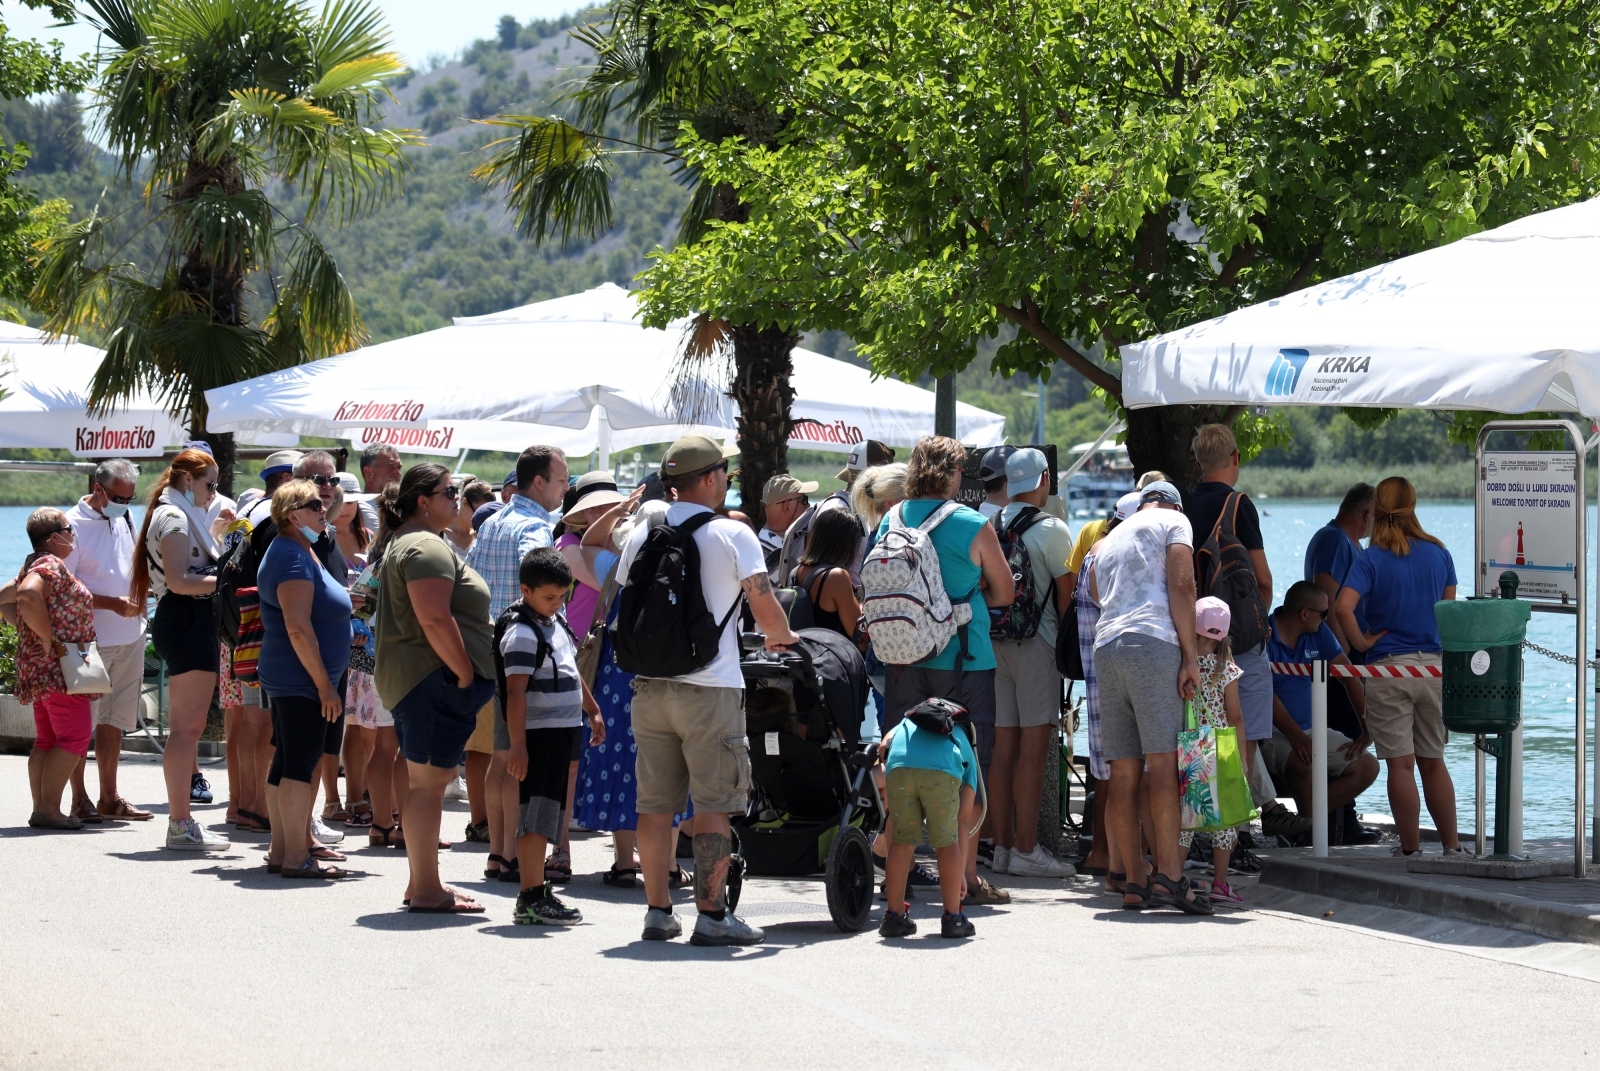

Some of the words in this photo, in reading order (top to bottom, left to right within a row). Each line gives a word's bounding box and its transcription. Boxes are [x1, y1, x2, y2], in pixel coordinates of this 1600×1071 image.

[1317, 356, 1371, 373] KRKA
[333, 399, 425, 422] Karlovačko
[75, 425, 156, 451] Karlovačko
[788, 417, 864, 445] arlovačko
[956, 489, 981, 502] OLAZAK
[1486, 483, 1506, 492] DOBRO
[1508, 481, 1524, 492] DOŠLI
[1526, 483, 1530, 492] U
[1532, 483, 1548, 492] LUKU
[1550, 483, 1576, 493] SKRADIN
[1491, 498, 1517, 507] WELCOME
[1517, 498, 1525, 507] TO
[1525, 498, 1538, 507] PORT
[1540, 499, 1547, 507] OF
[1547, 499, 1571, 508] SKRADIN
